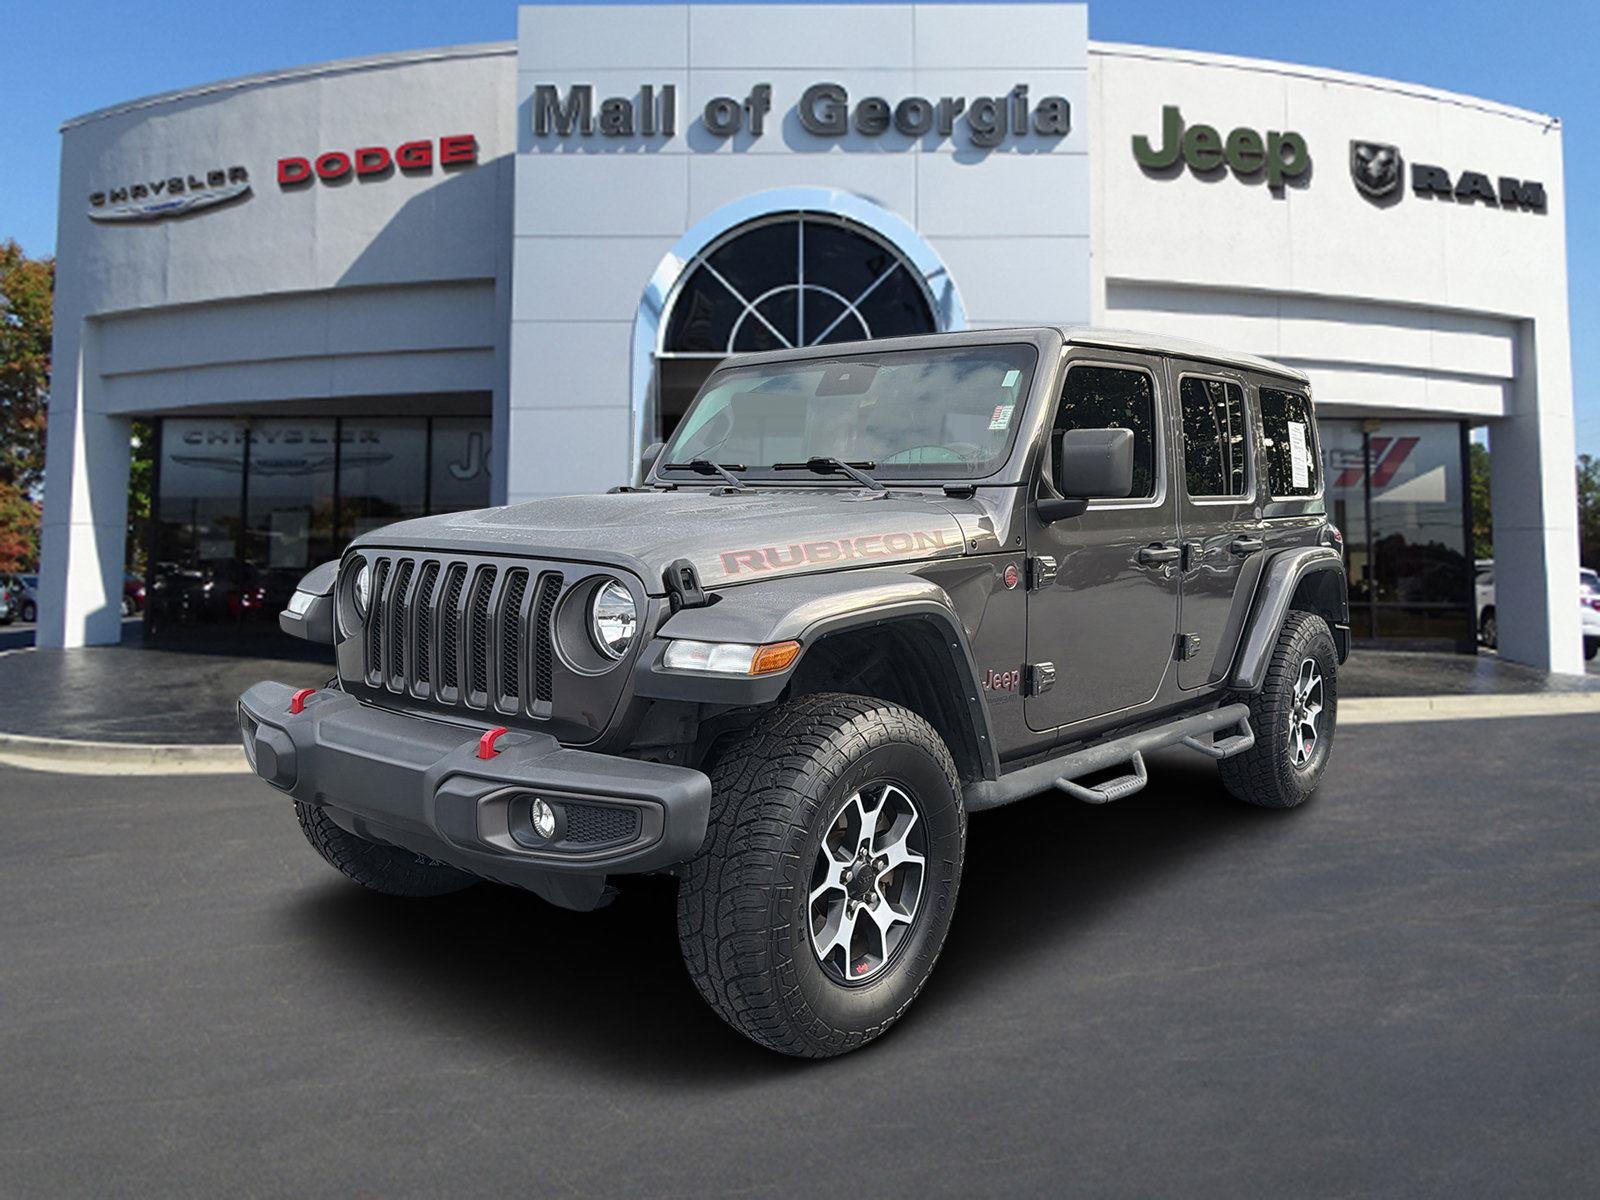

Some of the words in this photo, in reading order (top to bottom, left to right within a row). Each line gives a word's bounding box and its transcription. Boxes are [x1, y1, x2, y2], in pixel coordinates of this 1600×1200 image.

[533, 84, 676, 136] Mall
[704, 83, 771, 136] of
[800, 82, 1071, 148] Georgia
[277, 134, 476, 186] DODGE
[1132, 105, 1309, 190] Jeep
[90, 166, 249, 207] CHRYSLER
[1411, 163, 1546, 211] RAM
[183, 430, 381, 445] CHRYSLER
[720, 530, 947, 577] RUBICON
[982, 669, 1020, 691] Jeep
